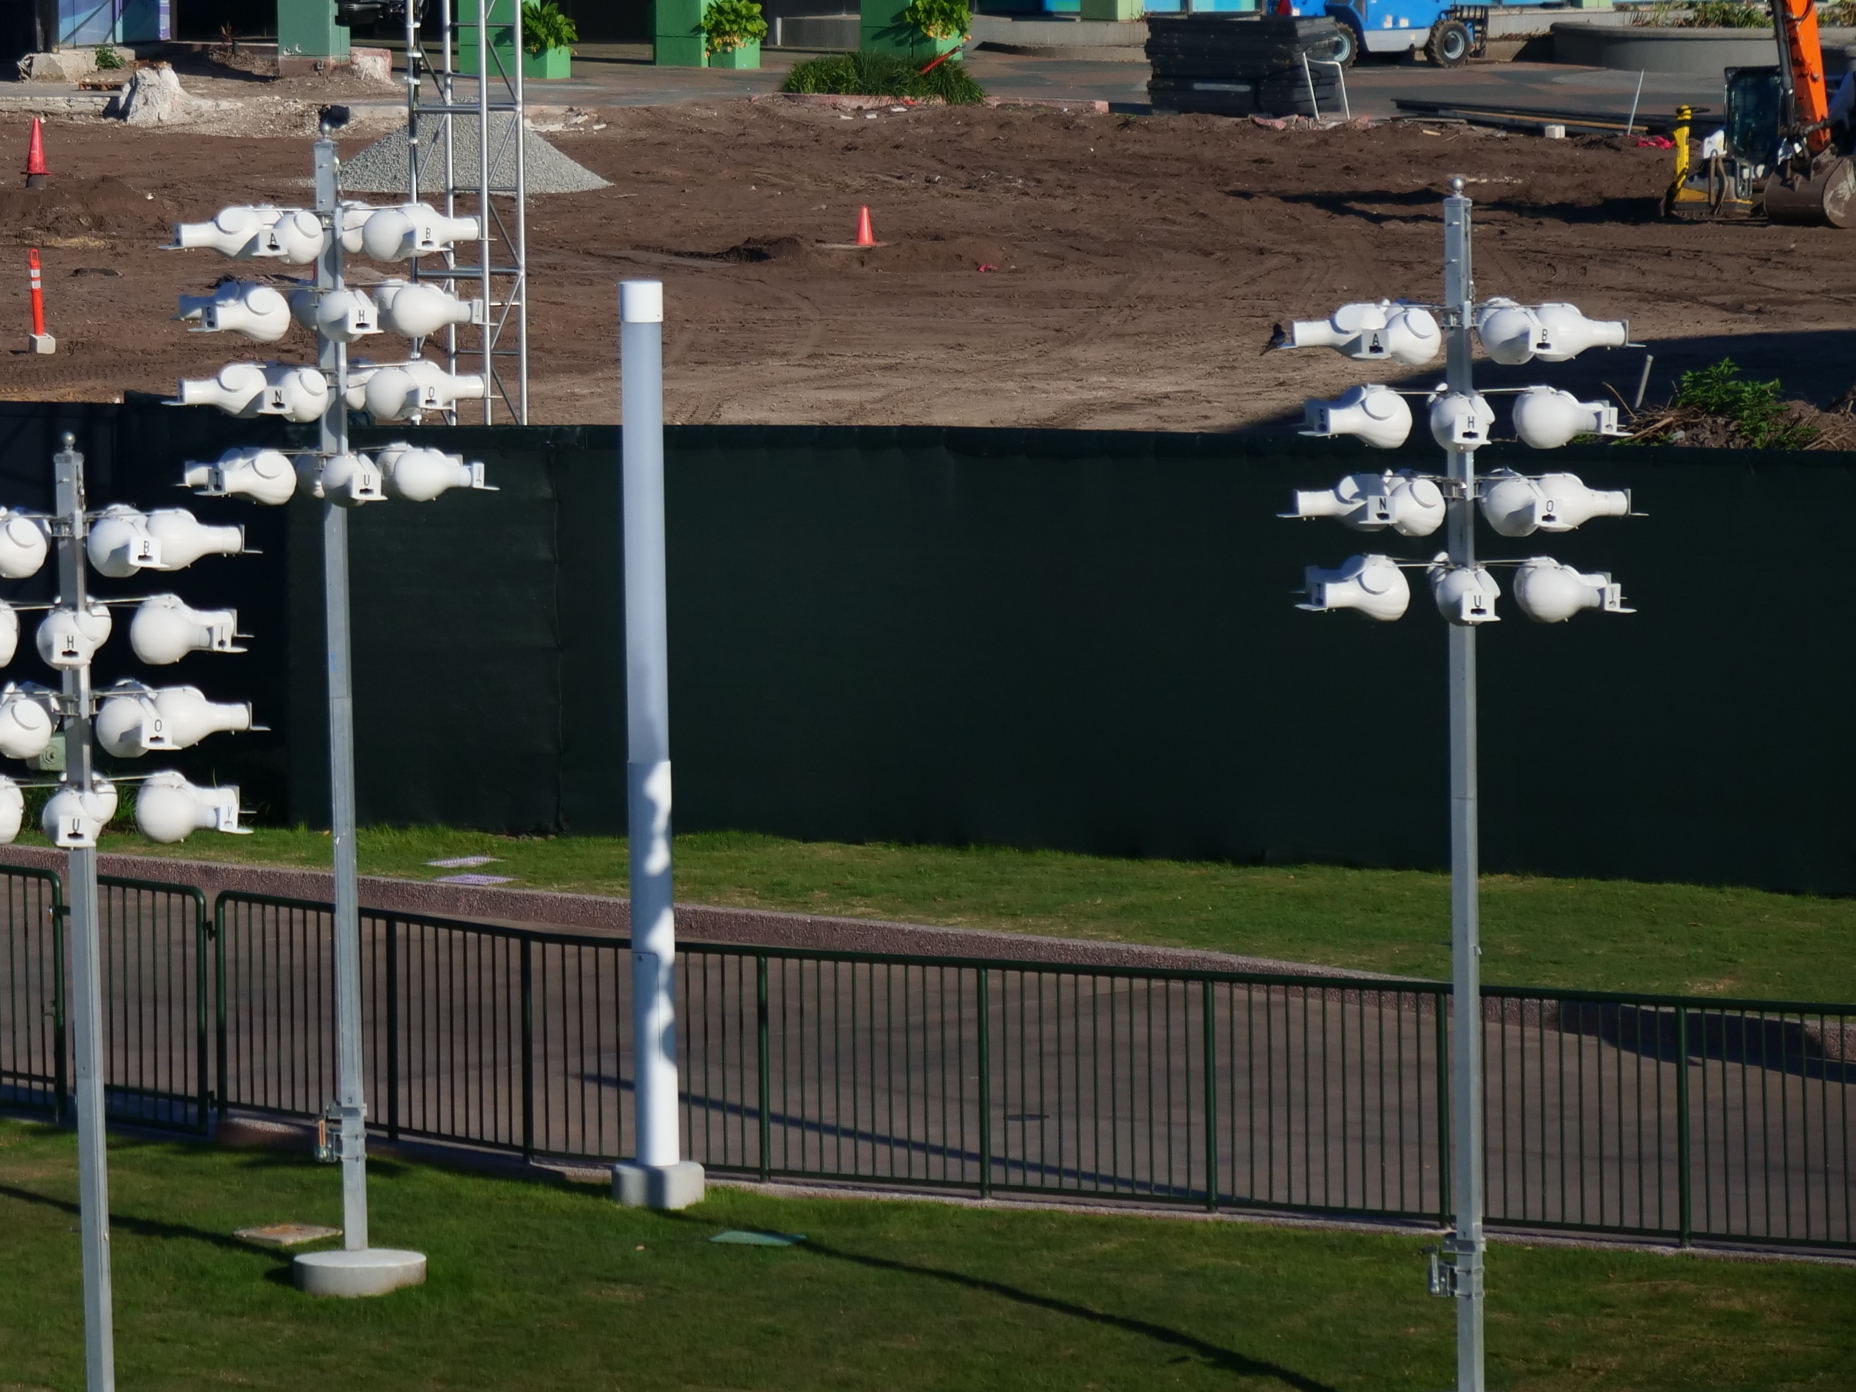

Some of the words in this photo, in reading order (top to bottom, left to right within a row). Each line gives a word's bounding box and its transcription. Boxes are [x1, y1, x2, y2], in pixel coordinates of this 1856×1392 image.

[269, 232, 277, 245] A
[425, 227, 432, 239] B
[358, 310, 365, 322] H
[1372, 333, 1380, 346] A
[1541, 328, 1548, 341] B
[274, 390, 282, 402] N
[1467, 416, 1475, 428] H
[363, 474, 370, 486] U
[1379, 497, 1386, 510] N
[143, 541, 150, 554] B
[1474, 595, 1481, 608] U
[67, 636, 75, 648] H
[72, 818, 80, 831] U
